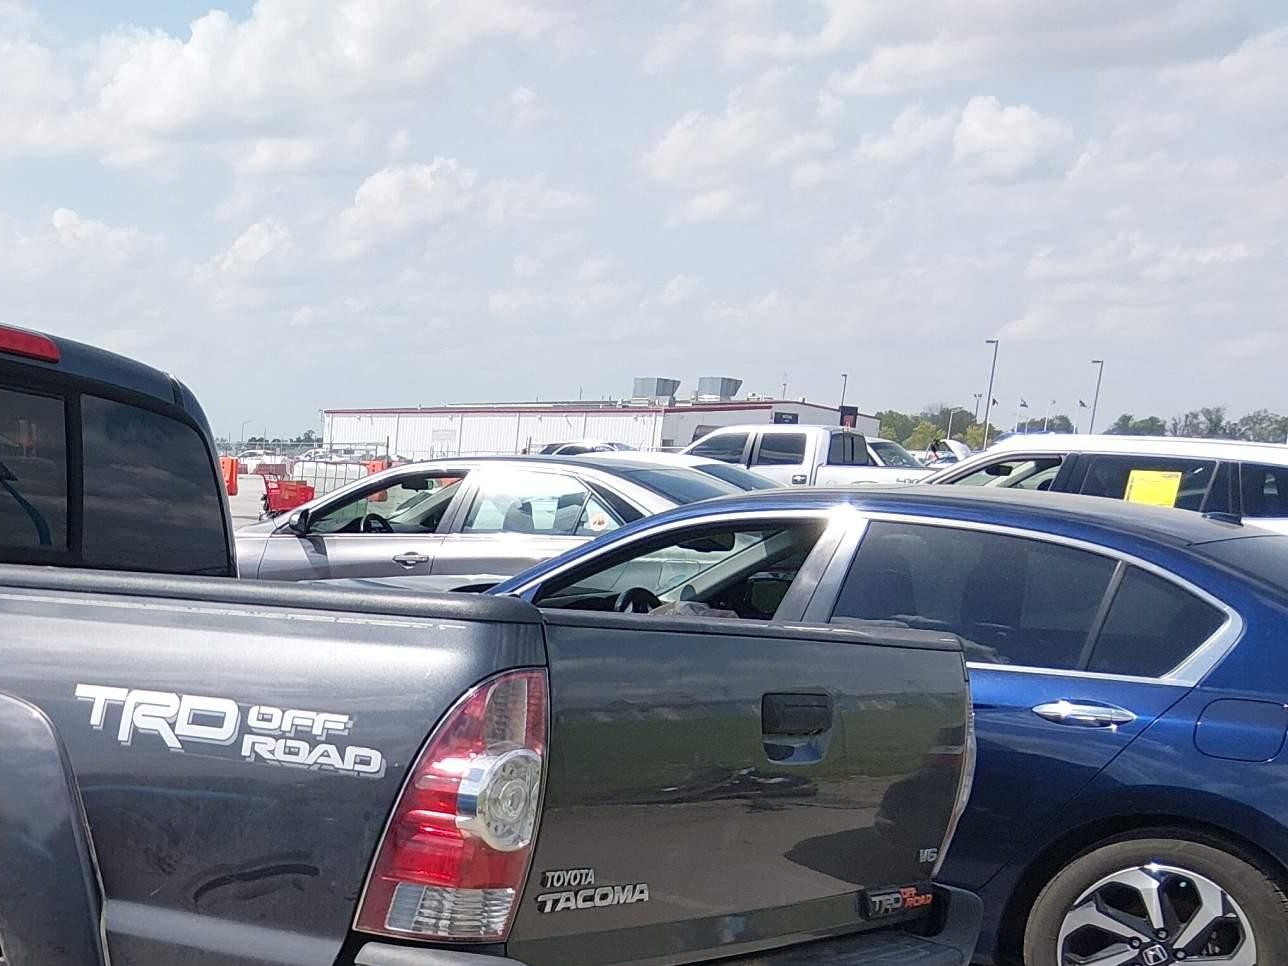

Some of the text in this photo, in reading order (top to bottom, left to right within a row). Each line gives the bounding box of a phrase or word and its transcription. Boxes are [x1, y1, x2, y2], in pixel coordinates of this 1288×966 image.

[74, 683, 240, 752] TRD
[247, 705, 354, 740] OFF
[241, 734, 387, 778] ROAD
[919, 848, 938, 863] V6
[545, 868, 595, 888] TOYOTA
[537, 883, 649, 913] TACOMA
